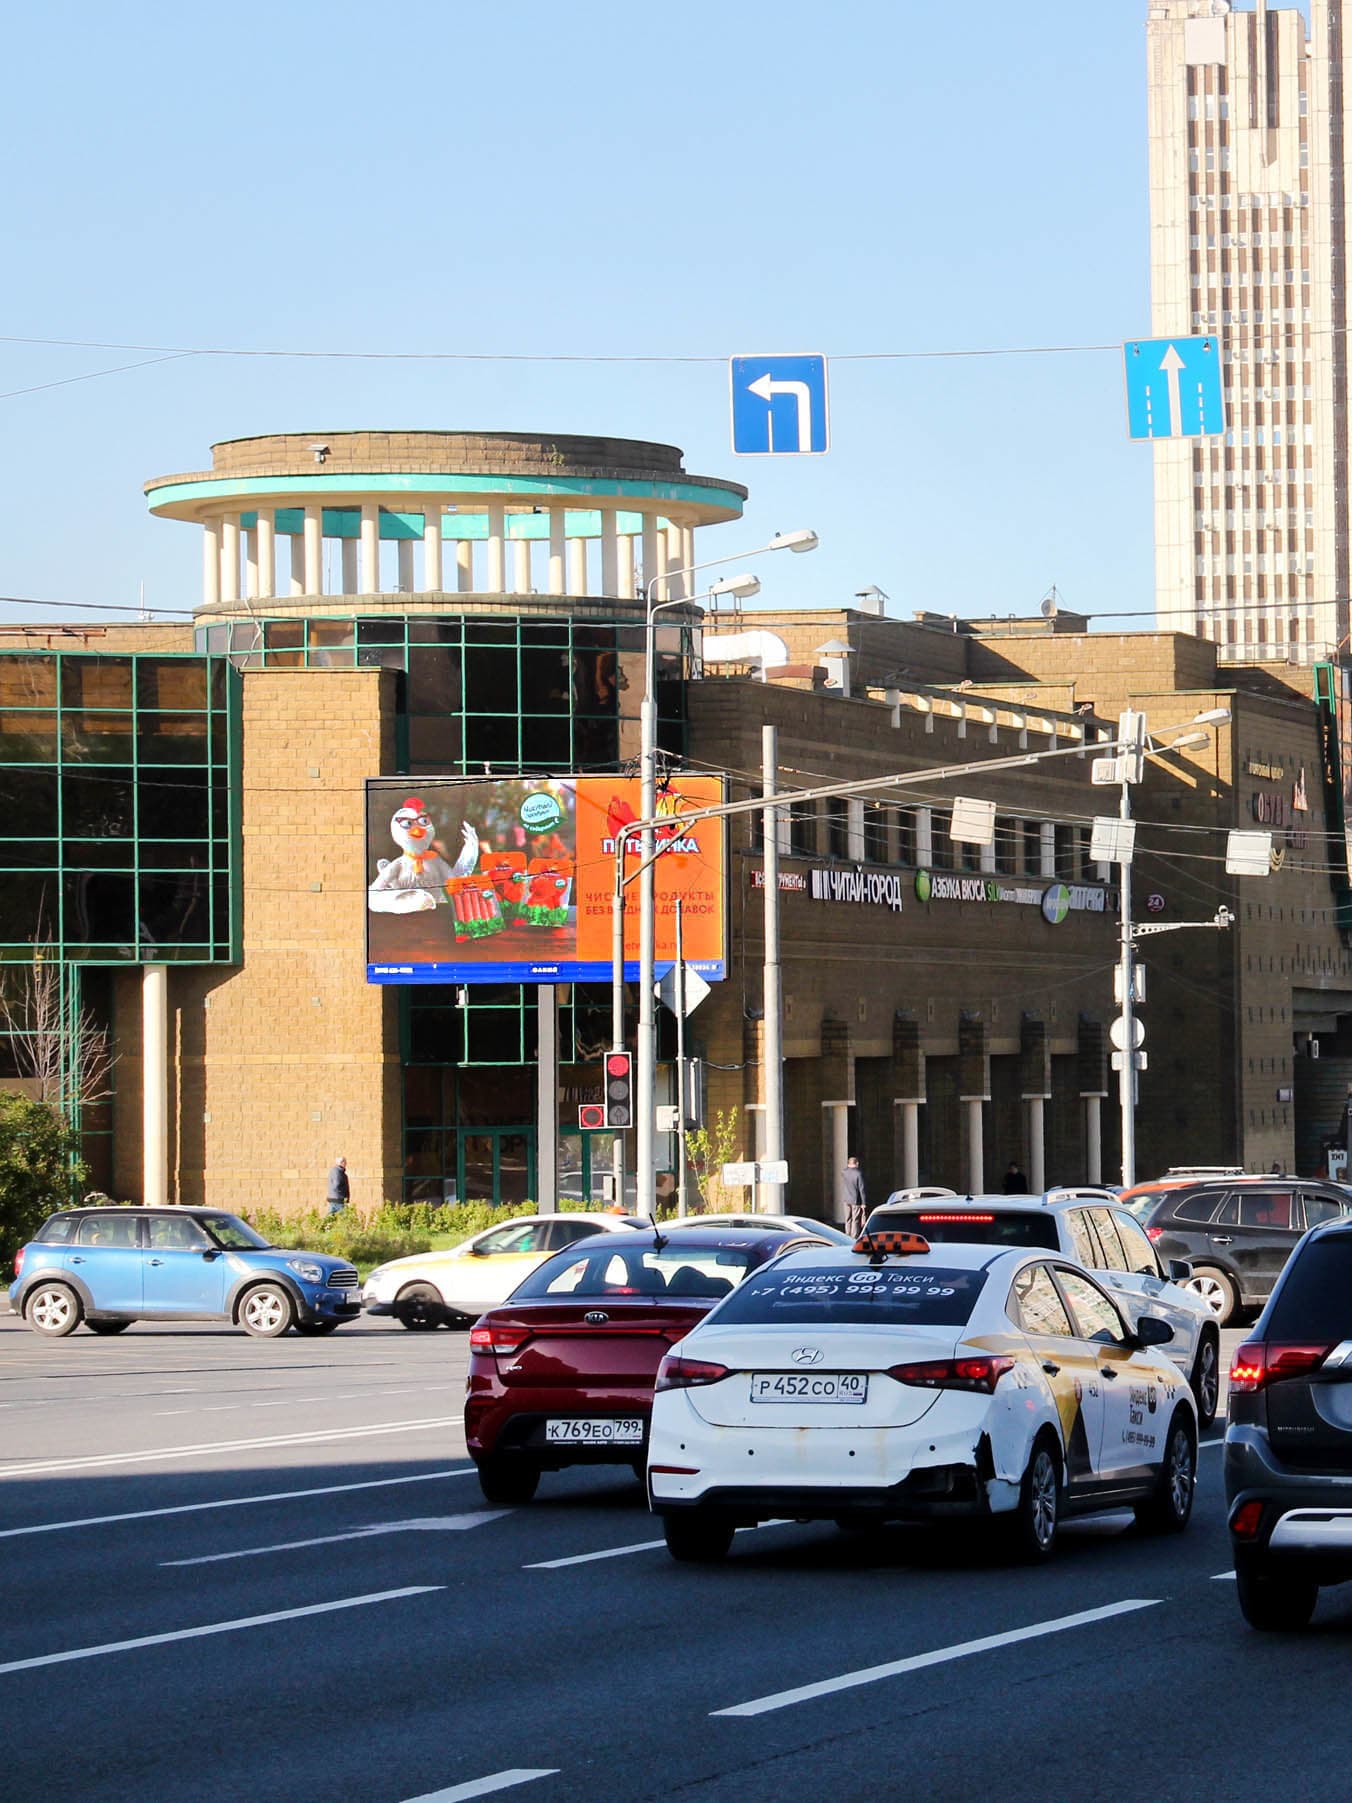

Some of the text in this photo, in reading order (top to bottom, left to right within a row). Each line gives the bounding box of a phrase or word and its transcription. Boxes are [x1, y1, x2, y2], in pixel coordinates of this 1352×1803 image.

[830, 865, 902, 912] ЧИТАЙ-ГОРОД
[931, 877, 961, 899] АЗБУКА
[961, 879, 986, 901] ВКУСА
[661, 904, 714, 915] ДОАВОК
[783, 1273, 845, 1284] Яндекс
[887, 1273, 935, 1284] Такси
[779, 1285, 839, 1296] (495)
[845, 1285, 887, 1295] 999
[892, 1285, 921, 1295] 99
[926, 1287, 955, 1297] 99
[840, 1376, 860, 1390] 40
[615, 1420, 639, 1433] 799
